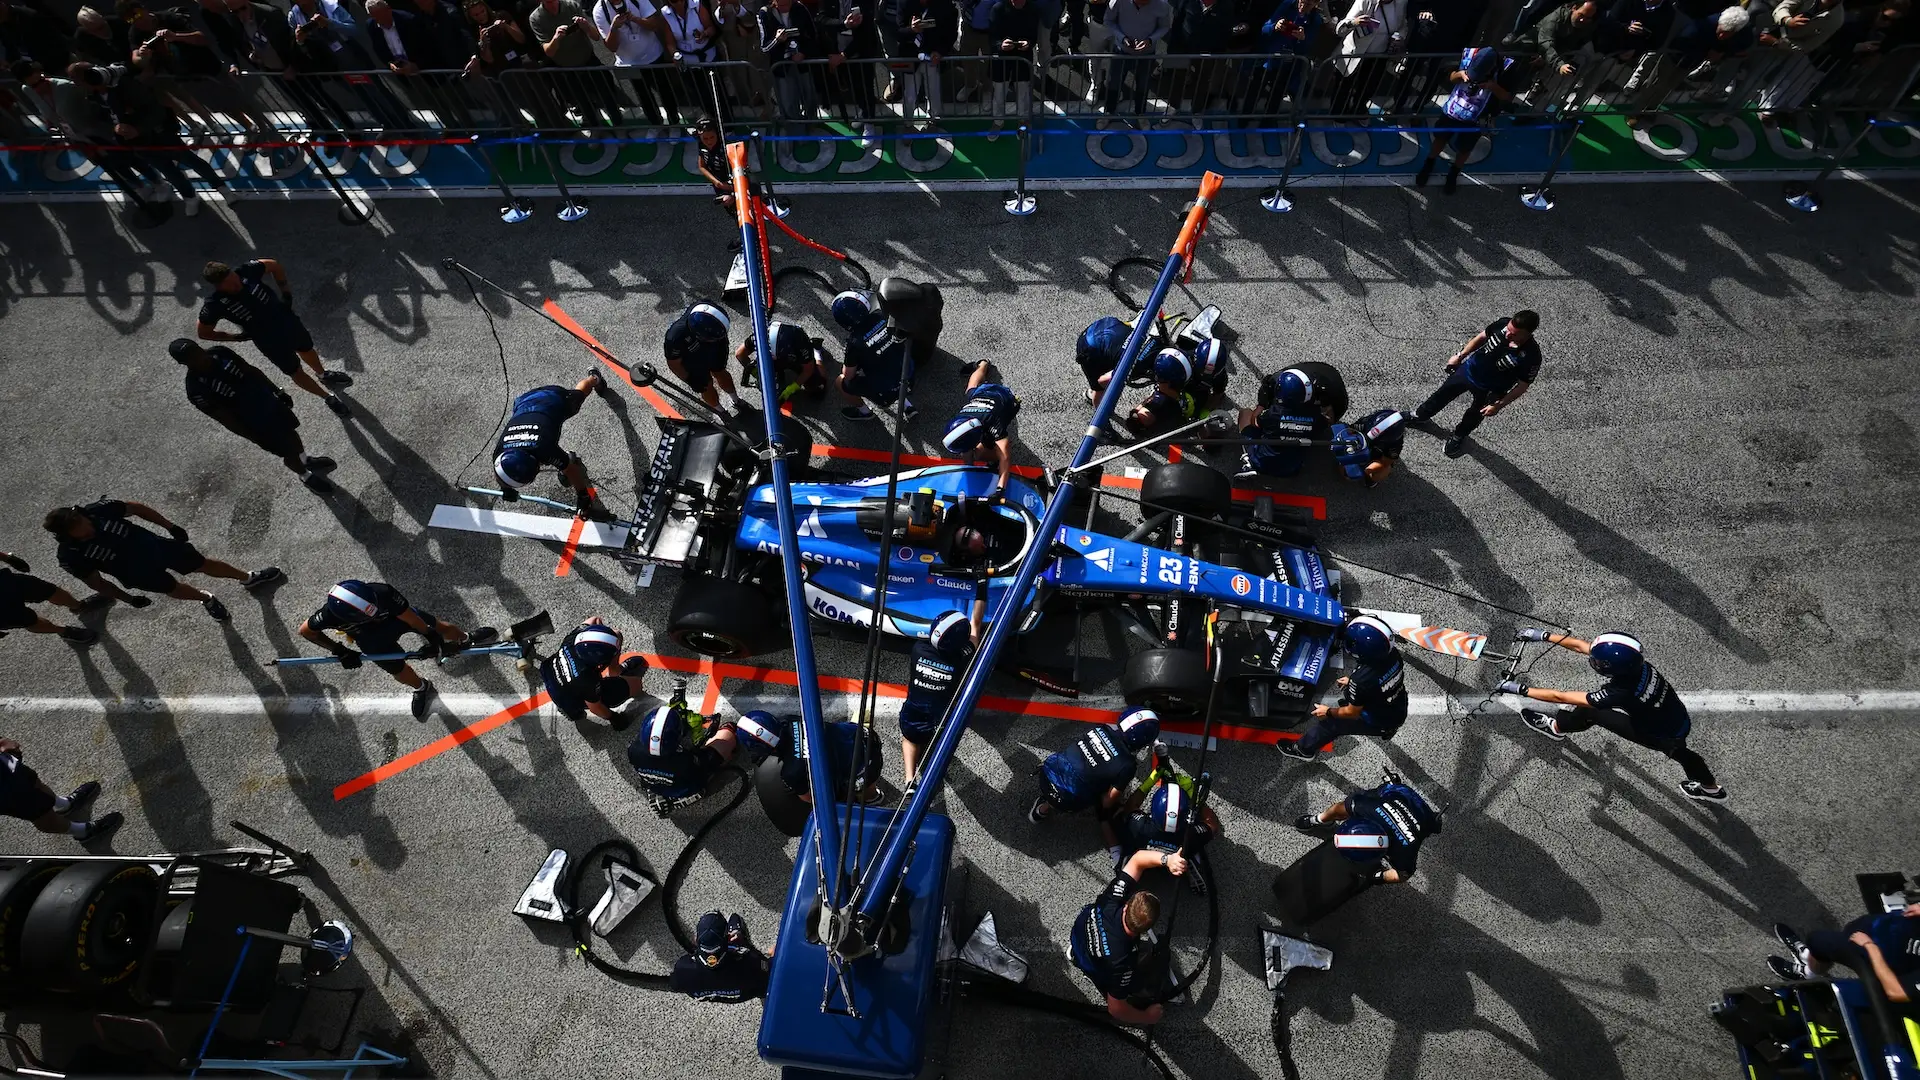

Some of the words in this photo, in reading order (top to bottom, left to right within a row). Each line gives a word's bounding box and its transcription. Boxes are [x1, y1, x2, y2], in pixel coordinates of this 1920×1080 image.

[1174, 514, 1184, 539] Claude
[756, 540, 861, 571] ATSSIAN
[1140, 547, 1149, 577] BARCLAYS
[1271, 550, 1290, 587] ASSIAN
[884, 574, 915, 584] raken
[936, 578, 972, 591] Claude
[1158, 556, 1183, 585] 23
[1188, 557, 1199, 586] BNY
[1059, 590, 1115, 599] Stephens
[1168, 599, 1179, 631] Claude
[1271, 622, 1295, 668] ATLASSIAN
[916, 664, 953, 681] Williams
[922, 658, 954, 672] ATLASSIAN
[918, 681, 946, 691] BARCLAYS
[1087, 729, 1111, 762] Williams
[1099, 730, 1119, 757] ATLASSIAN
[1375, 807, 1402, 840] ATLASSIAN
[1382, 802, 1416, 843] Williams
[77, 903, 96, 958] ZERO
[1097, 911, 1111, 957] ATLASSIAN
